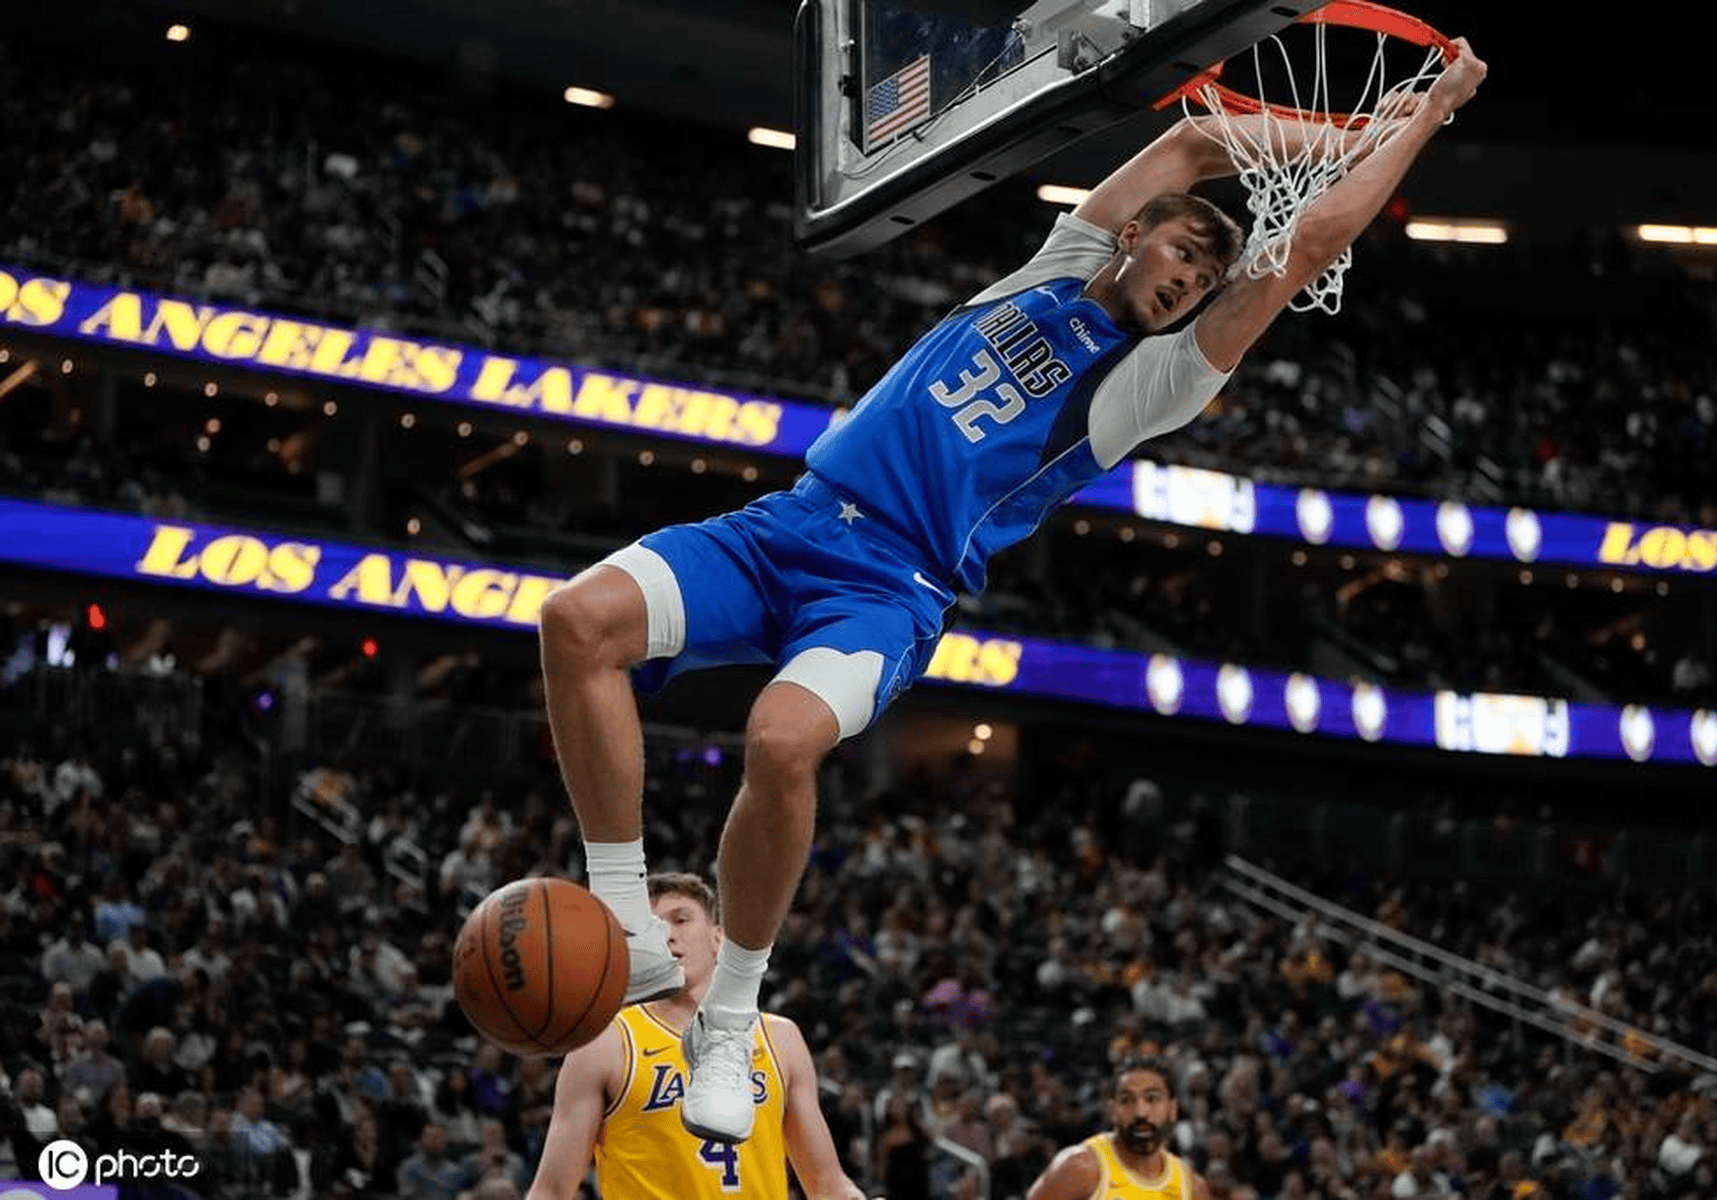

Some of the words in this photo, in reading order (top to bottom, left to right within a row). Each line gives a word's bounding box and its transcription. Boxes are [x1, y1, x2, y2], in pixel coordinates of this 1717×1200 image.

[0, 270, 71, 326] S
[78, 291, 463, 394] ANGELES
[470, 355, 783, 446] LAKERS
[1069, 317, 1100, 354] chime
[929, 349, 1026, 443] 32
[135, 524, 322, 594] LOS
[1598, 521, 1717, 572] LOS
[699, 1138, 740, 1189] 4
